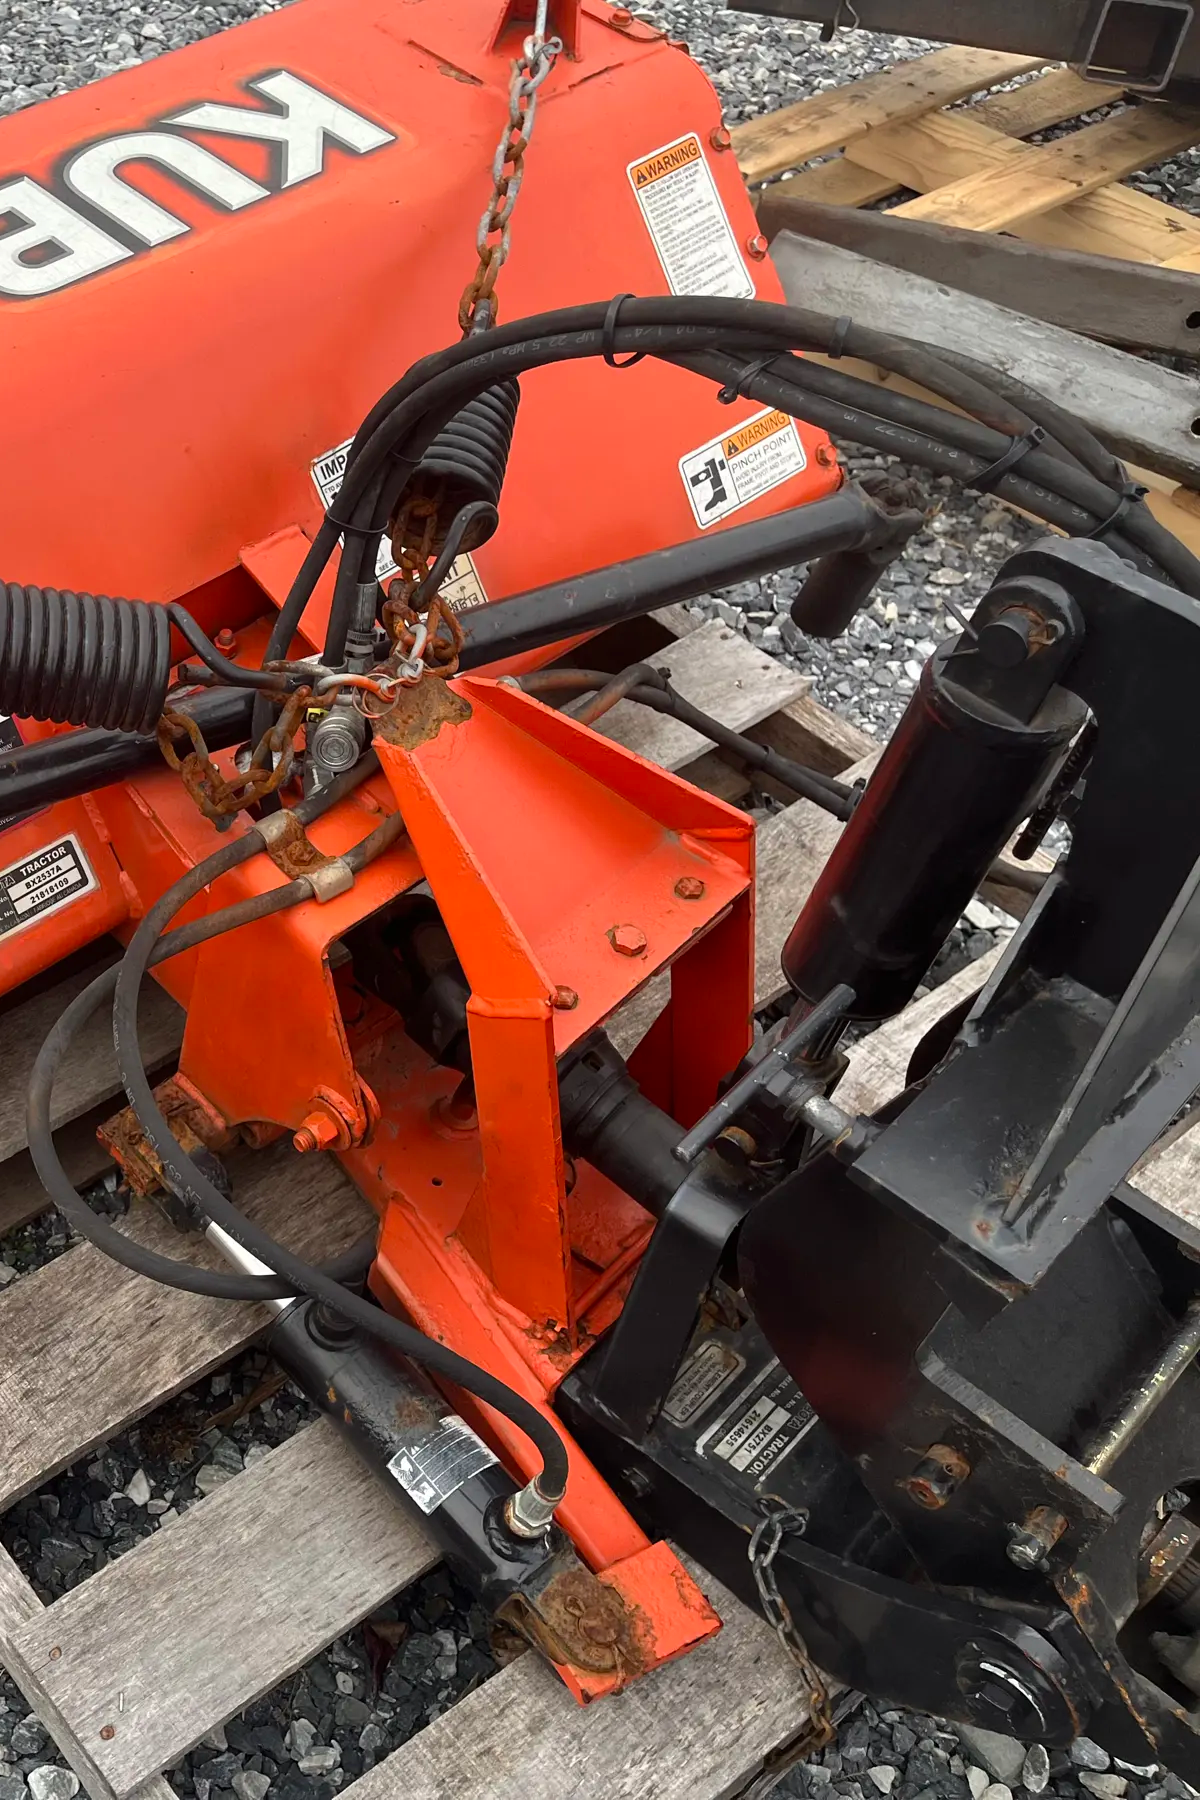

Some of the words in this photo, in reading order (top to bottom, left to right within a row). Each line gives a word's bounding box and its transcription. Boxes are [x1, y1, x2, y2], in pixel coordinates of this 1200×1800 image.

[646, 143, 698, 178] WARNING
[737, 412, 786, 447] WARNING
[731, 449, 762, 472] PINCH
[762, 431, 793, 454] POINT
[735, 470, 751, 482] AVOID
[751, 460, 768, 473] INJURY
[768, 451, 782, 462] FROM
[737, 476, 755, 489] FRAME
[769, 461, 781, 471] AND
[20, 846, 66, 876] TRACTOR
[25, 864, 62, 889] BX2537A
[30, 878, 69, 903] 21818109
[64, 883, 81, 895] CANADA
[702, 1363, 728, 1391] PLEMENT
[778, 1376, 792, 1389] RIAL
[725, 1410, 760, 1447] 21614655
[787, 1404, 814, 1431] BOTA
[744, 1424, 772, 1454] BX2751
